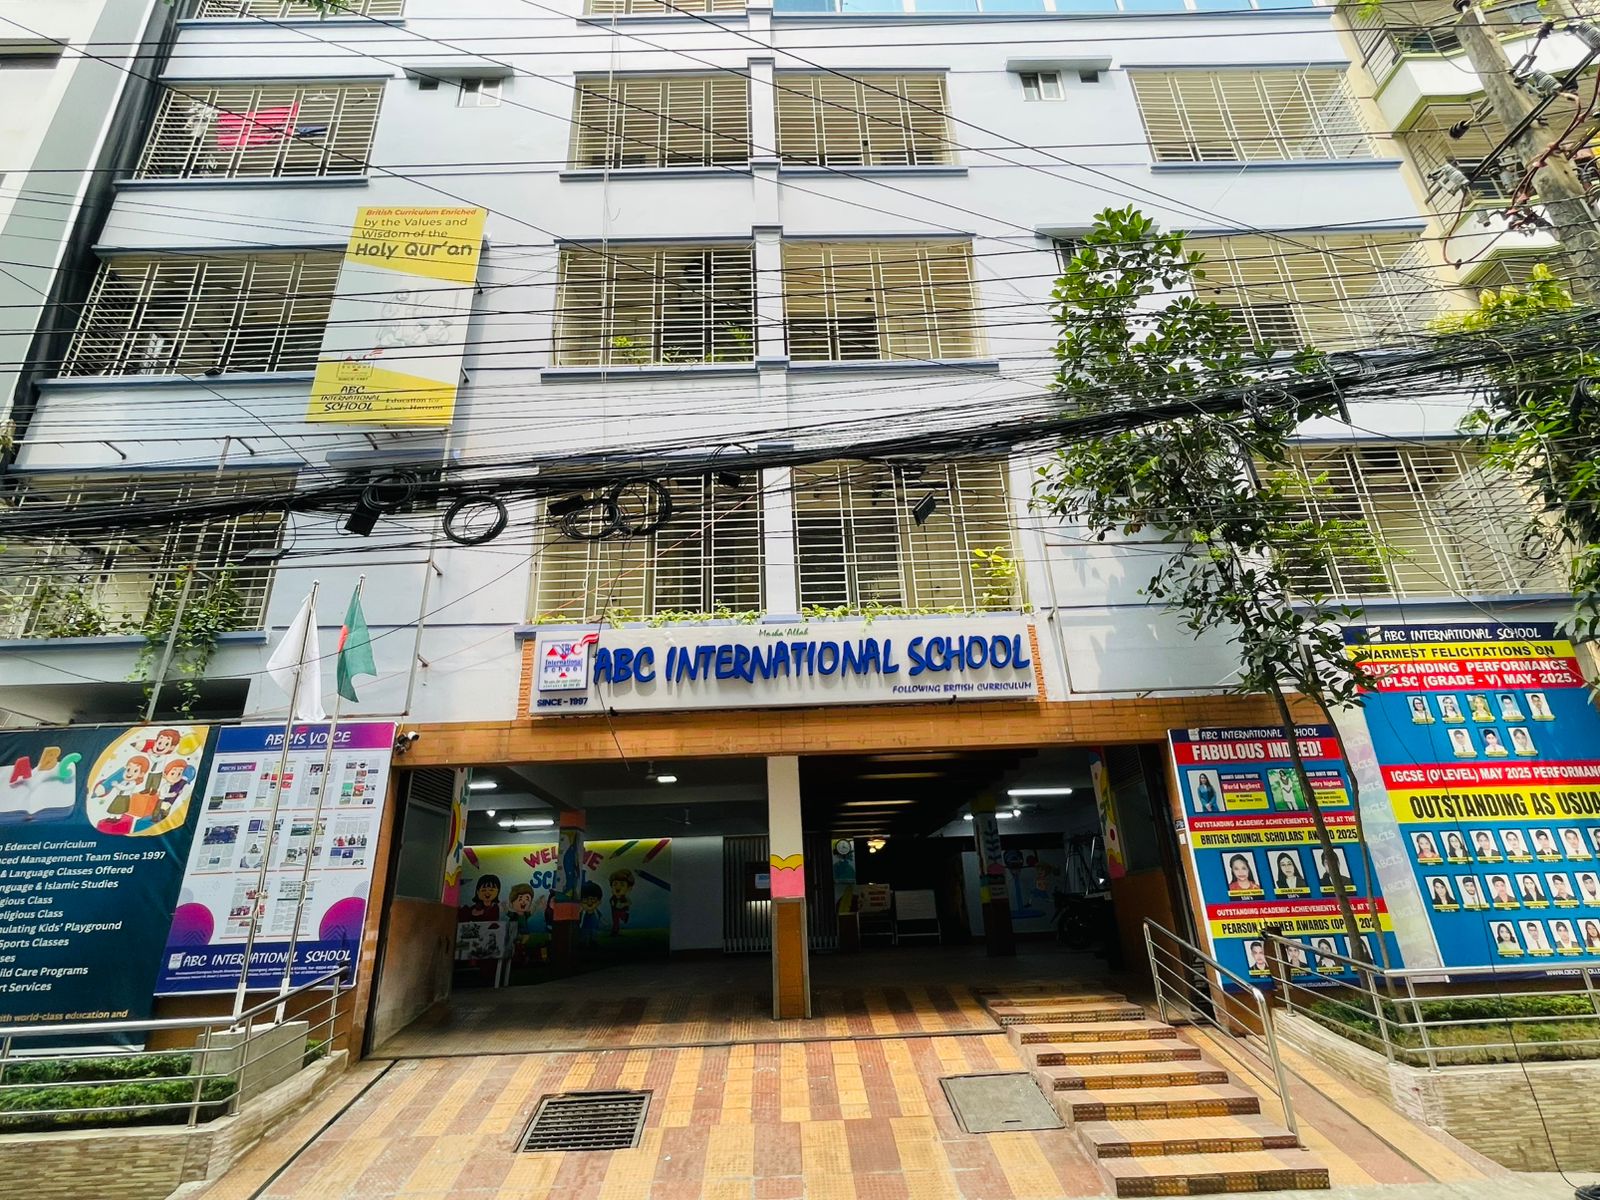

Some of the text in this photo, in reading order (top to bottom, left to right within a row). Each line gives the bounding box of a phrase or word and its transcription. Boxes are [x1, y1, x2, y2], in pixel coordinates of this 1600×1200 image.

[364, 219, 378, 228] by
[404, 218, 442, 226] Values
[445, 218, 467, 226] and
[361, 229, 448, 238] Wisdom of the
[355, 242, 399, 260] Holy
[340, 386, 365, 395] ABC
[324, 402, 373, 411] SCHOOL
[1384, 627, 1541, 642] ABC INTERNATIONAL SCHOOL
[1360, 645, 1555, 659] WARMEST FELICITATIONS ON
[594, 634, 1030, 685] ABC INTERNATIONAL SCHOOL
[1361, 660, 1569, 676] OUTSTANDING PERFORMANCE
[1381, 676, 1419, 688] IPLSC
[1423, 674, 1475, 688] (GRADE
[1486, 674, 1501, 687] V)
[1539, 672, 1577, 683] 2025.
[892, 682, 1032, 693] FOLLOWING BRITISH CURRICULUM
[537, 698, 562, 707] SINCE
[570, 697, 588, 706] 1997
[1201, 731, 1218, 740] ABC
[1221, 729, 1283, 740] INTERNATIONAL
[1192, 741, 1324, 761] FABULOUS INDED!
[1390, 770, 1425, 783] IGCSE
[1427, 768, 1479, 784] (O'LEVEL)
[1481, 767, 1503, 780] MAY
[1506, 767, 1531, 779] 2025
[1409, 793, 1529, 818] OUTSTANDING
[1530, 792, 1556, 816] AS
[1194, 821, 1235, 829] OUTSTANDING
[1236, 819, 1265, 827] ACADEMIC
[1266, 817, 1308, 825] ACHIEVEMENTS
[1200, 834, 1230, 845] BRITISH
[1231, 832, 1264, 844] COUNCIL
[1264, 830, 1305, 843] SCHOLARS'
[1336, 829, 1358, 839] 2025
[5, 841, 41, 851] Edexcel
[43, 840, 97, 850] Curriculum
[21, 854, 83, 865] Management
[85, 853, 110, 862] Team
[113, 852, 140, 861] Since
[142, 851, 166, 860] 1997
[9, 868, 54, 879] Language
[57, 867, 93, 876] Classes
[95, 865, 134, 875] Offered
[35, 882, 43, 890] &
[44, 881, 79, 890] Islamic
[81, 880, 119, 889] Studies
[27, 896, 53, 904] Class
[37, 909, 63, 918] Class
[1217, 908, 1259, 916] OUTSTANDING
[1260, 906, 1291, 914] ACADEMIC
[1291, 904, 1336, 912] ACHIEVEMENTS
[38, 922, 62, 933] Kids'
[65, 921, 122, 932] Playground
[1222, 922, 1258, 934] PEARSON
[1296, 919, 1329, 932] AWARDS
[32, 938, 69, 947] Classes
[182, 955, 207, 966] ABC
[305, 950, 351, 963] SCHOOL
[15, 967, 38, 977] Care
[40, 966, 89, 977] Programs
[9, 982, 52, 992] Services
[14, 1012, 63, 1021] world-class
[65, 1010, 110, 1020] education
[111, 1009, 129, 1019] and
